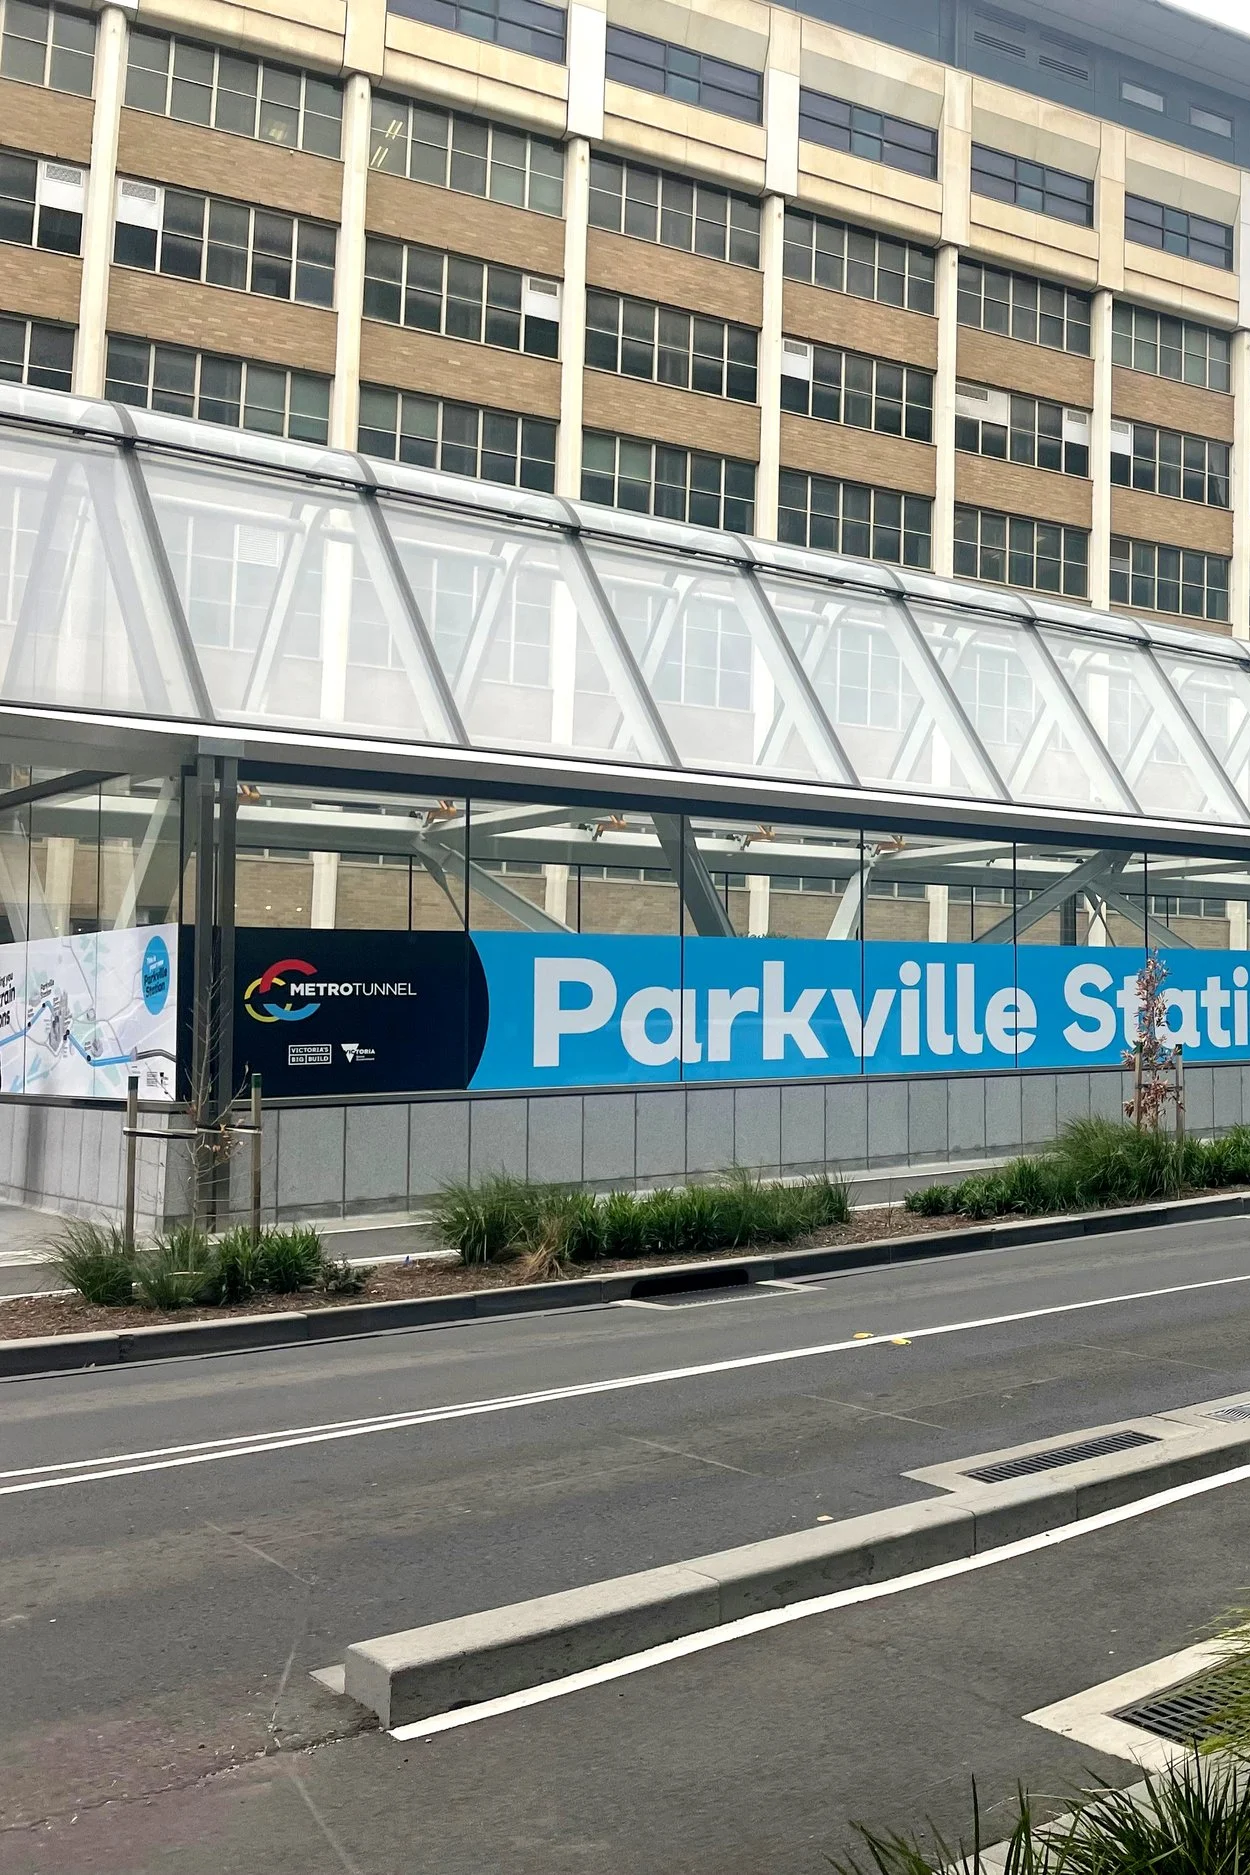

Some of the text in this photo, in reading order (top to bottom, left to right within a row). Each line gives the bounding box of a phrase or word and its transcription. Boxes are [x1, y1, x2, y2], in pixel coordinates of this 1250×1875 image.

[0, 983, 16, 1007] rain
[290, 982, 417, 997] METROTUNNEL
[533, 957, 1038, 1067] Parkville
